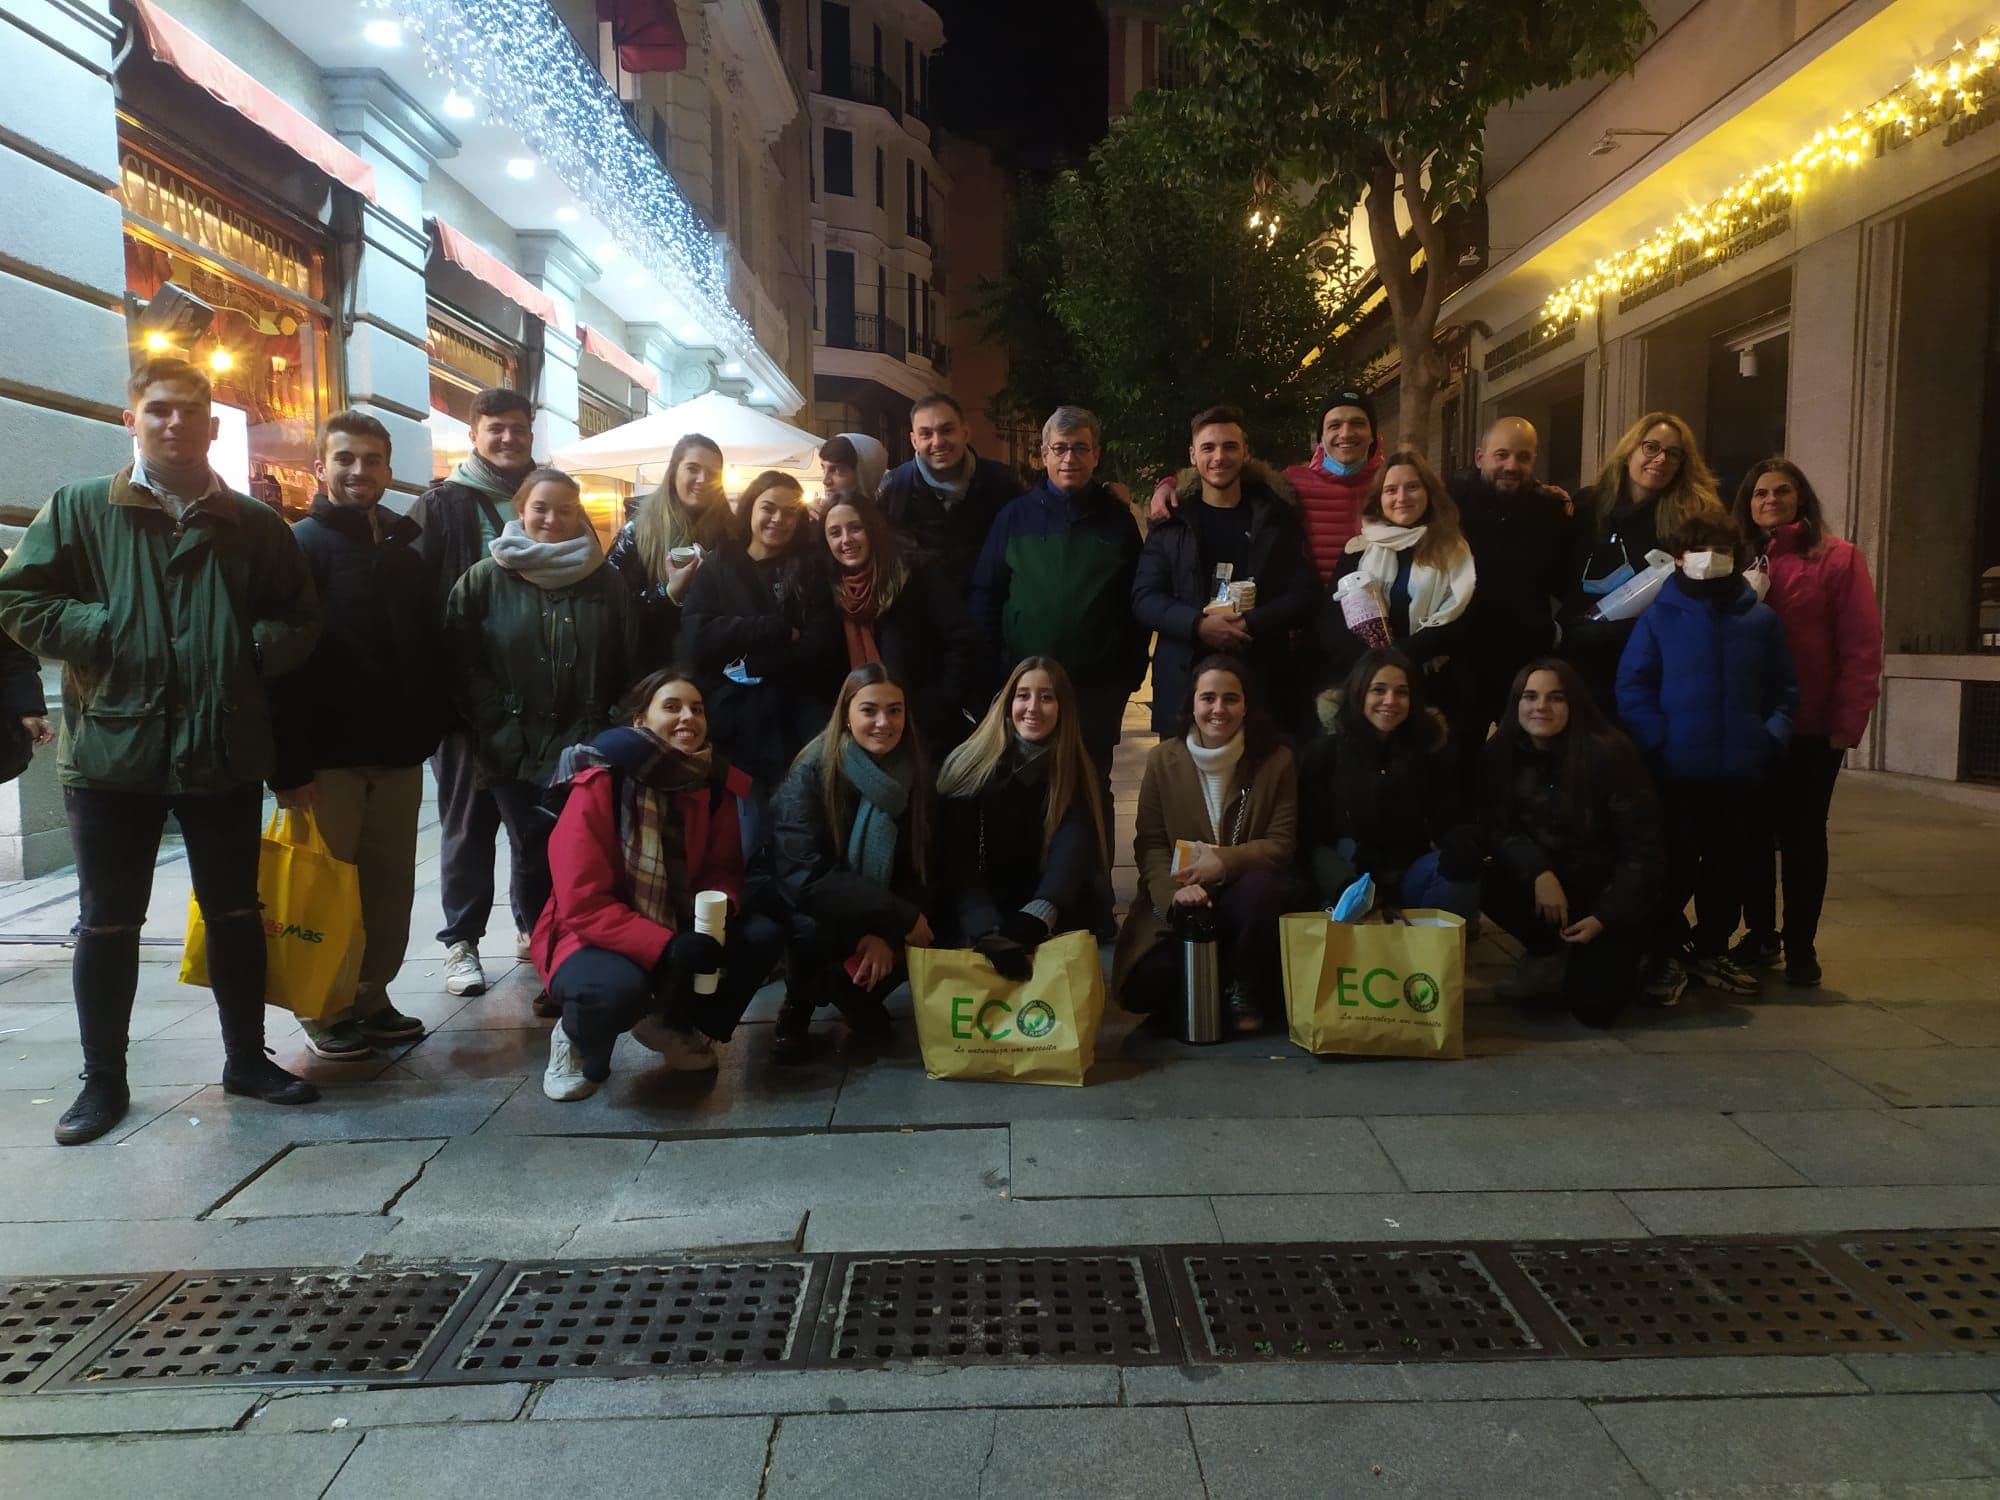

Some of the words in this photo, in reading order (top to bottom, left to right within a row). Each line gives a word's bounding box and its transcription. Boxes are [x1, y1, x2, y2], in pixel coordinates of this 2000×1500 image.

[121, 153, 301, 288] CHARCUTERIA
[1337, 967, 1440, 1013] ECO
[952, 998, 1056, 1040] ECO
